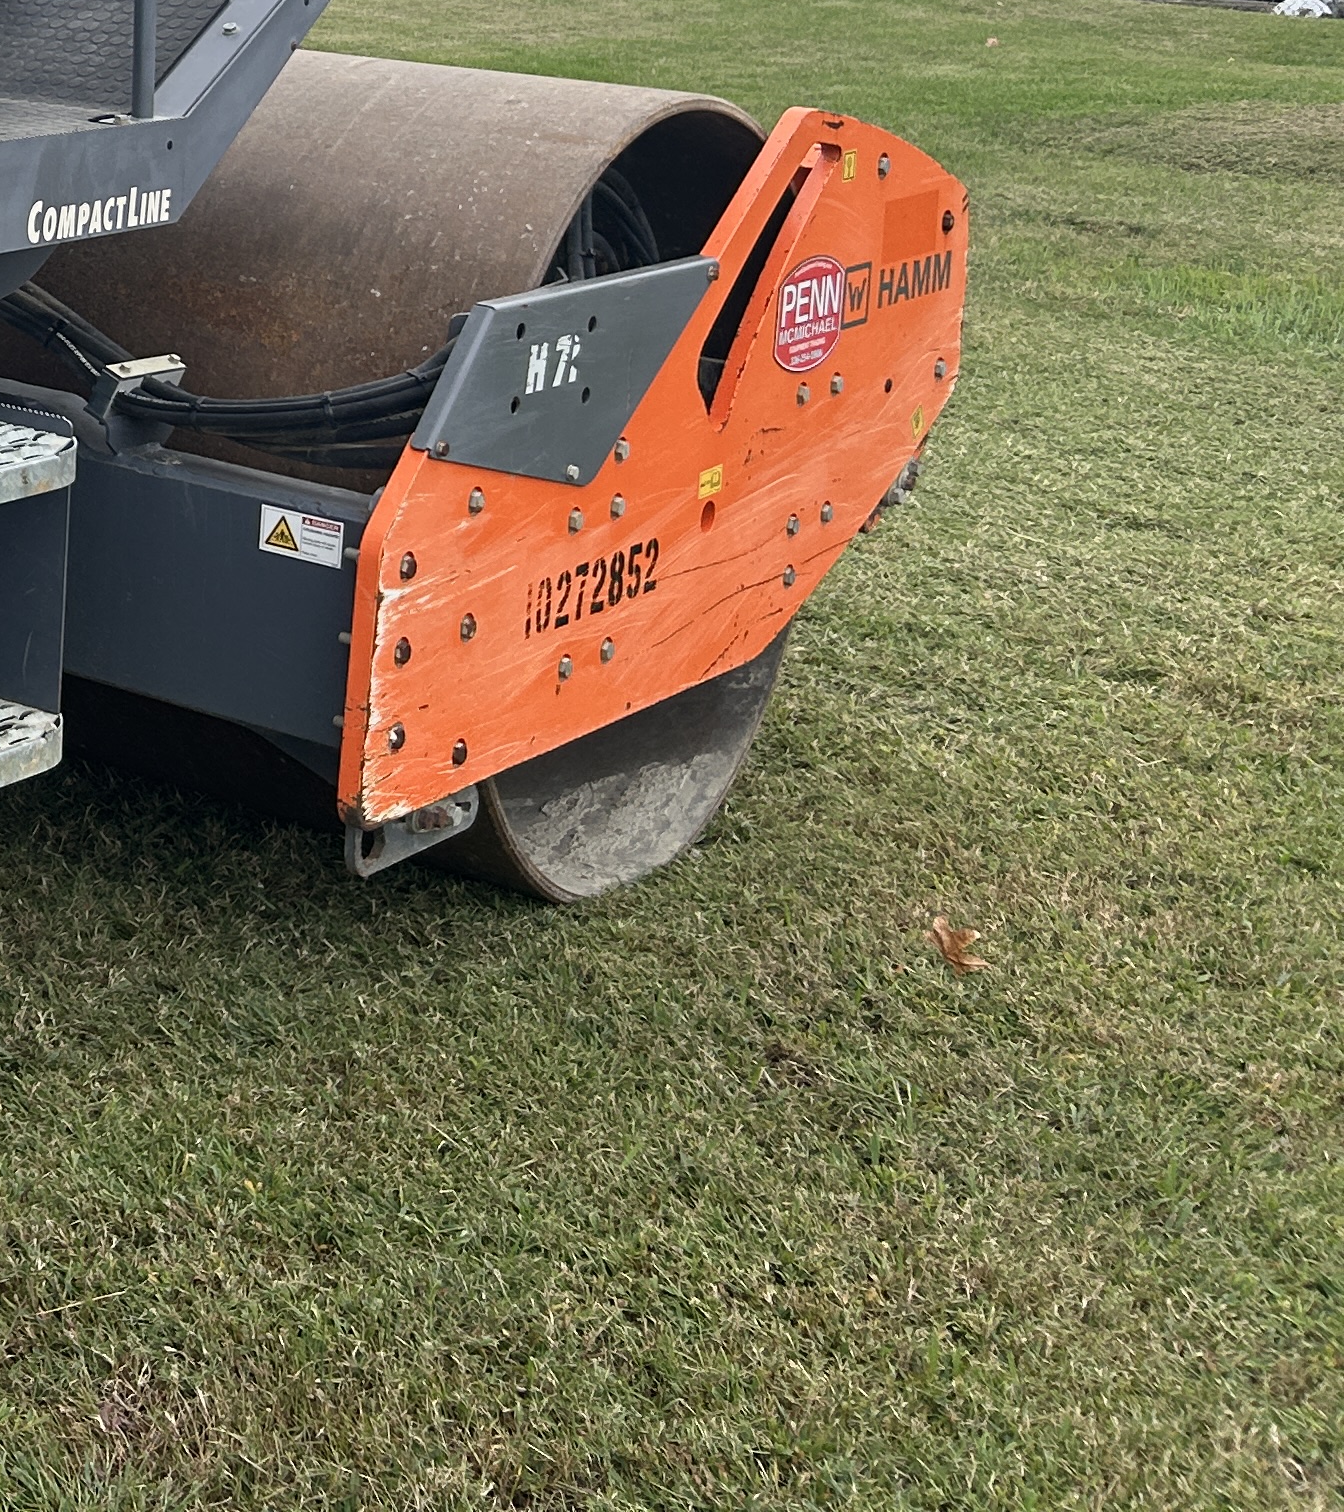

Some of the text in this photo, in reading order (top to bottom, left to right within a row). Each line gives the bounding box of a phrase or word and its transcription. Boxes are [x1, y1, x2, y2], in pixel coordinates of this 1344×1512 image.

[780, 271, 842, 329] PENN
[877, 250, 952, 310] HAMM
[524, 537, 660, 640] 10272852
